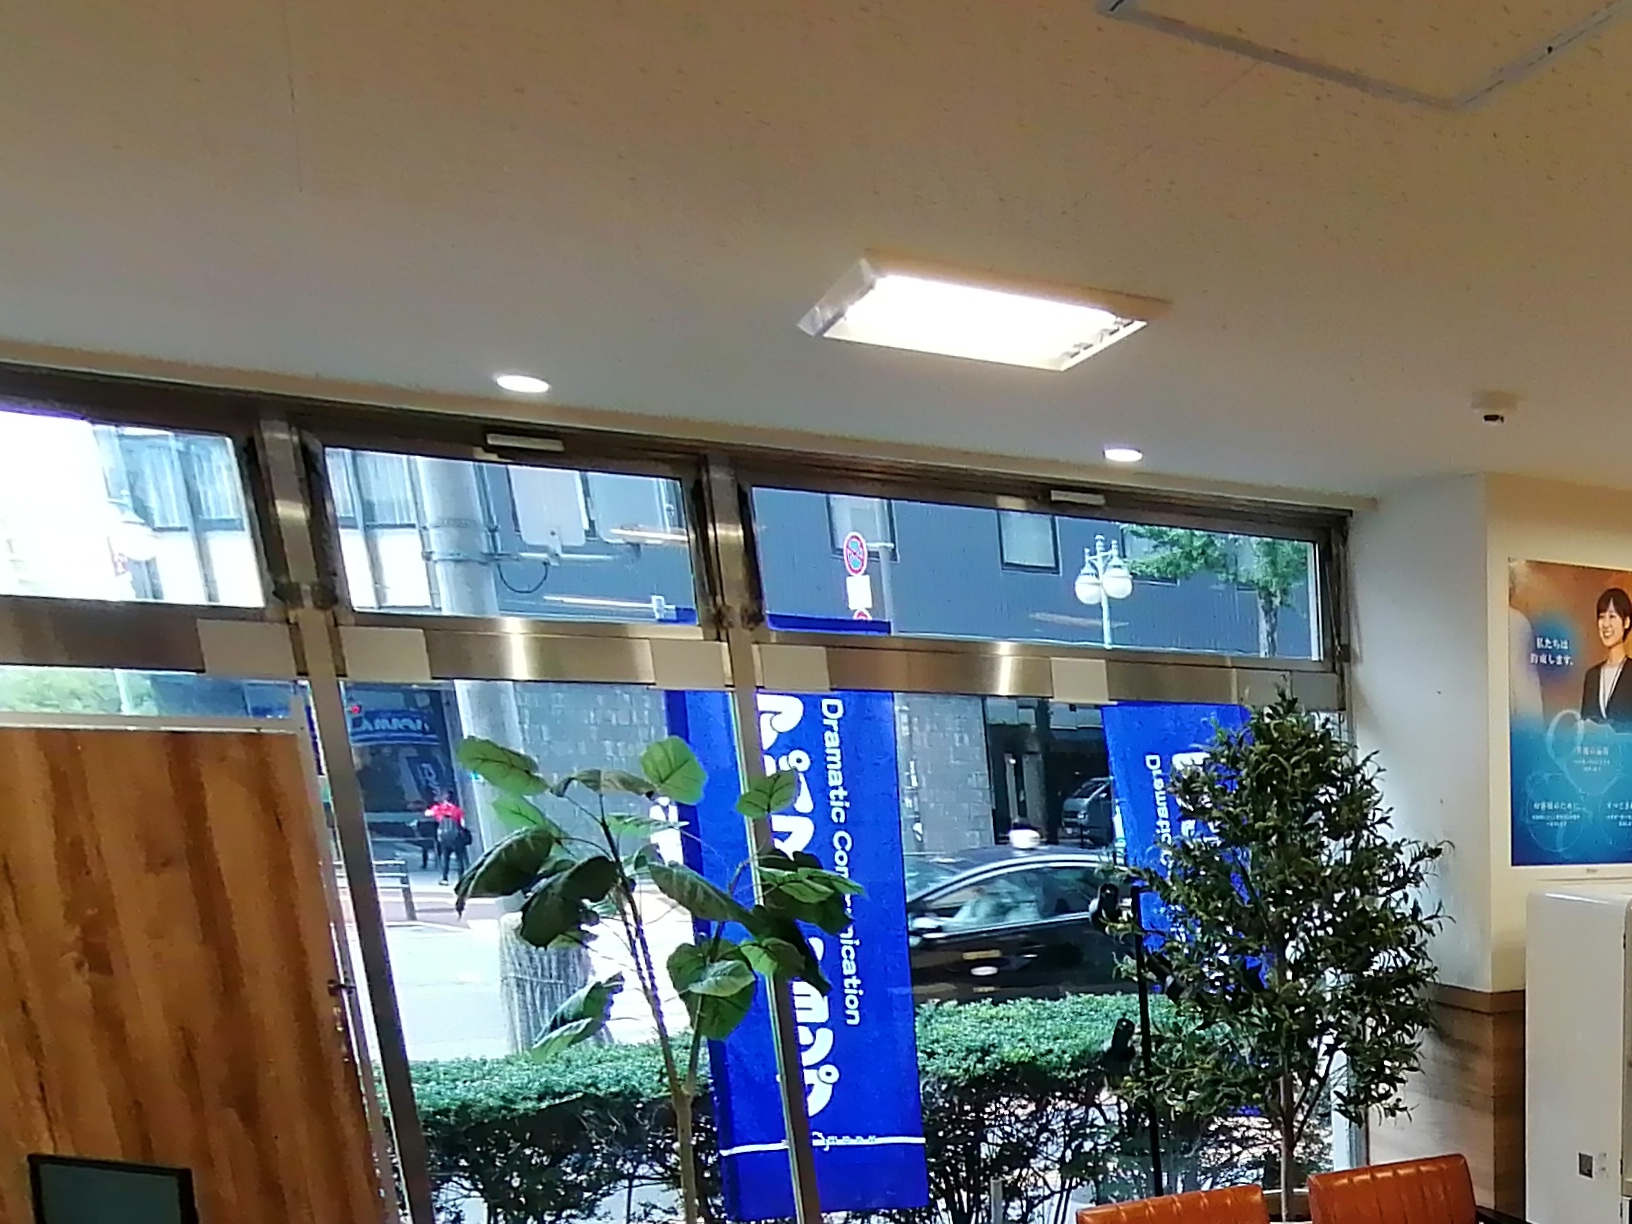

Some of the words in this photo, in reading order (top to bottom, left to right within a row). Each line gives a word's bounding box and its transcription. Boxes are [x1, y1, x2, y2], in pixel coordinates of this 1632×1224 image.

[1536, 637, 1569, 650] 私たちは
[821, 697, 850, 824] Dramatic
[832, 830, 864, 1027] Conication
